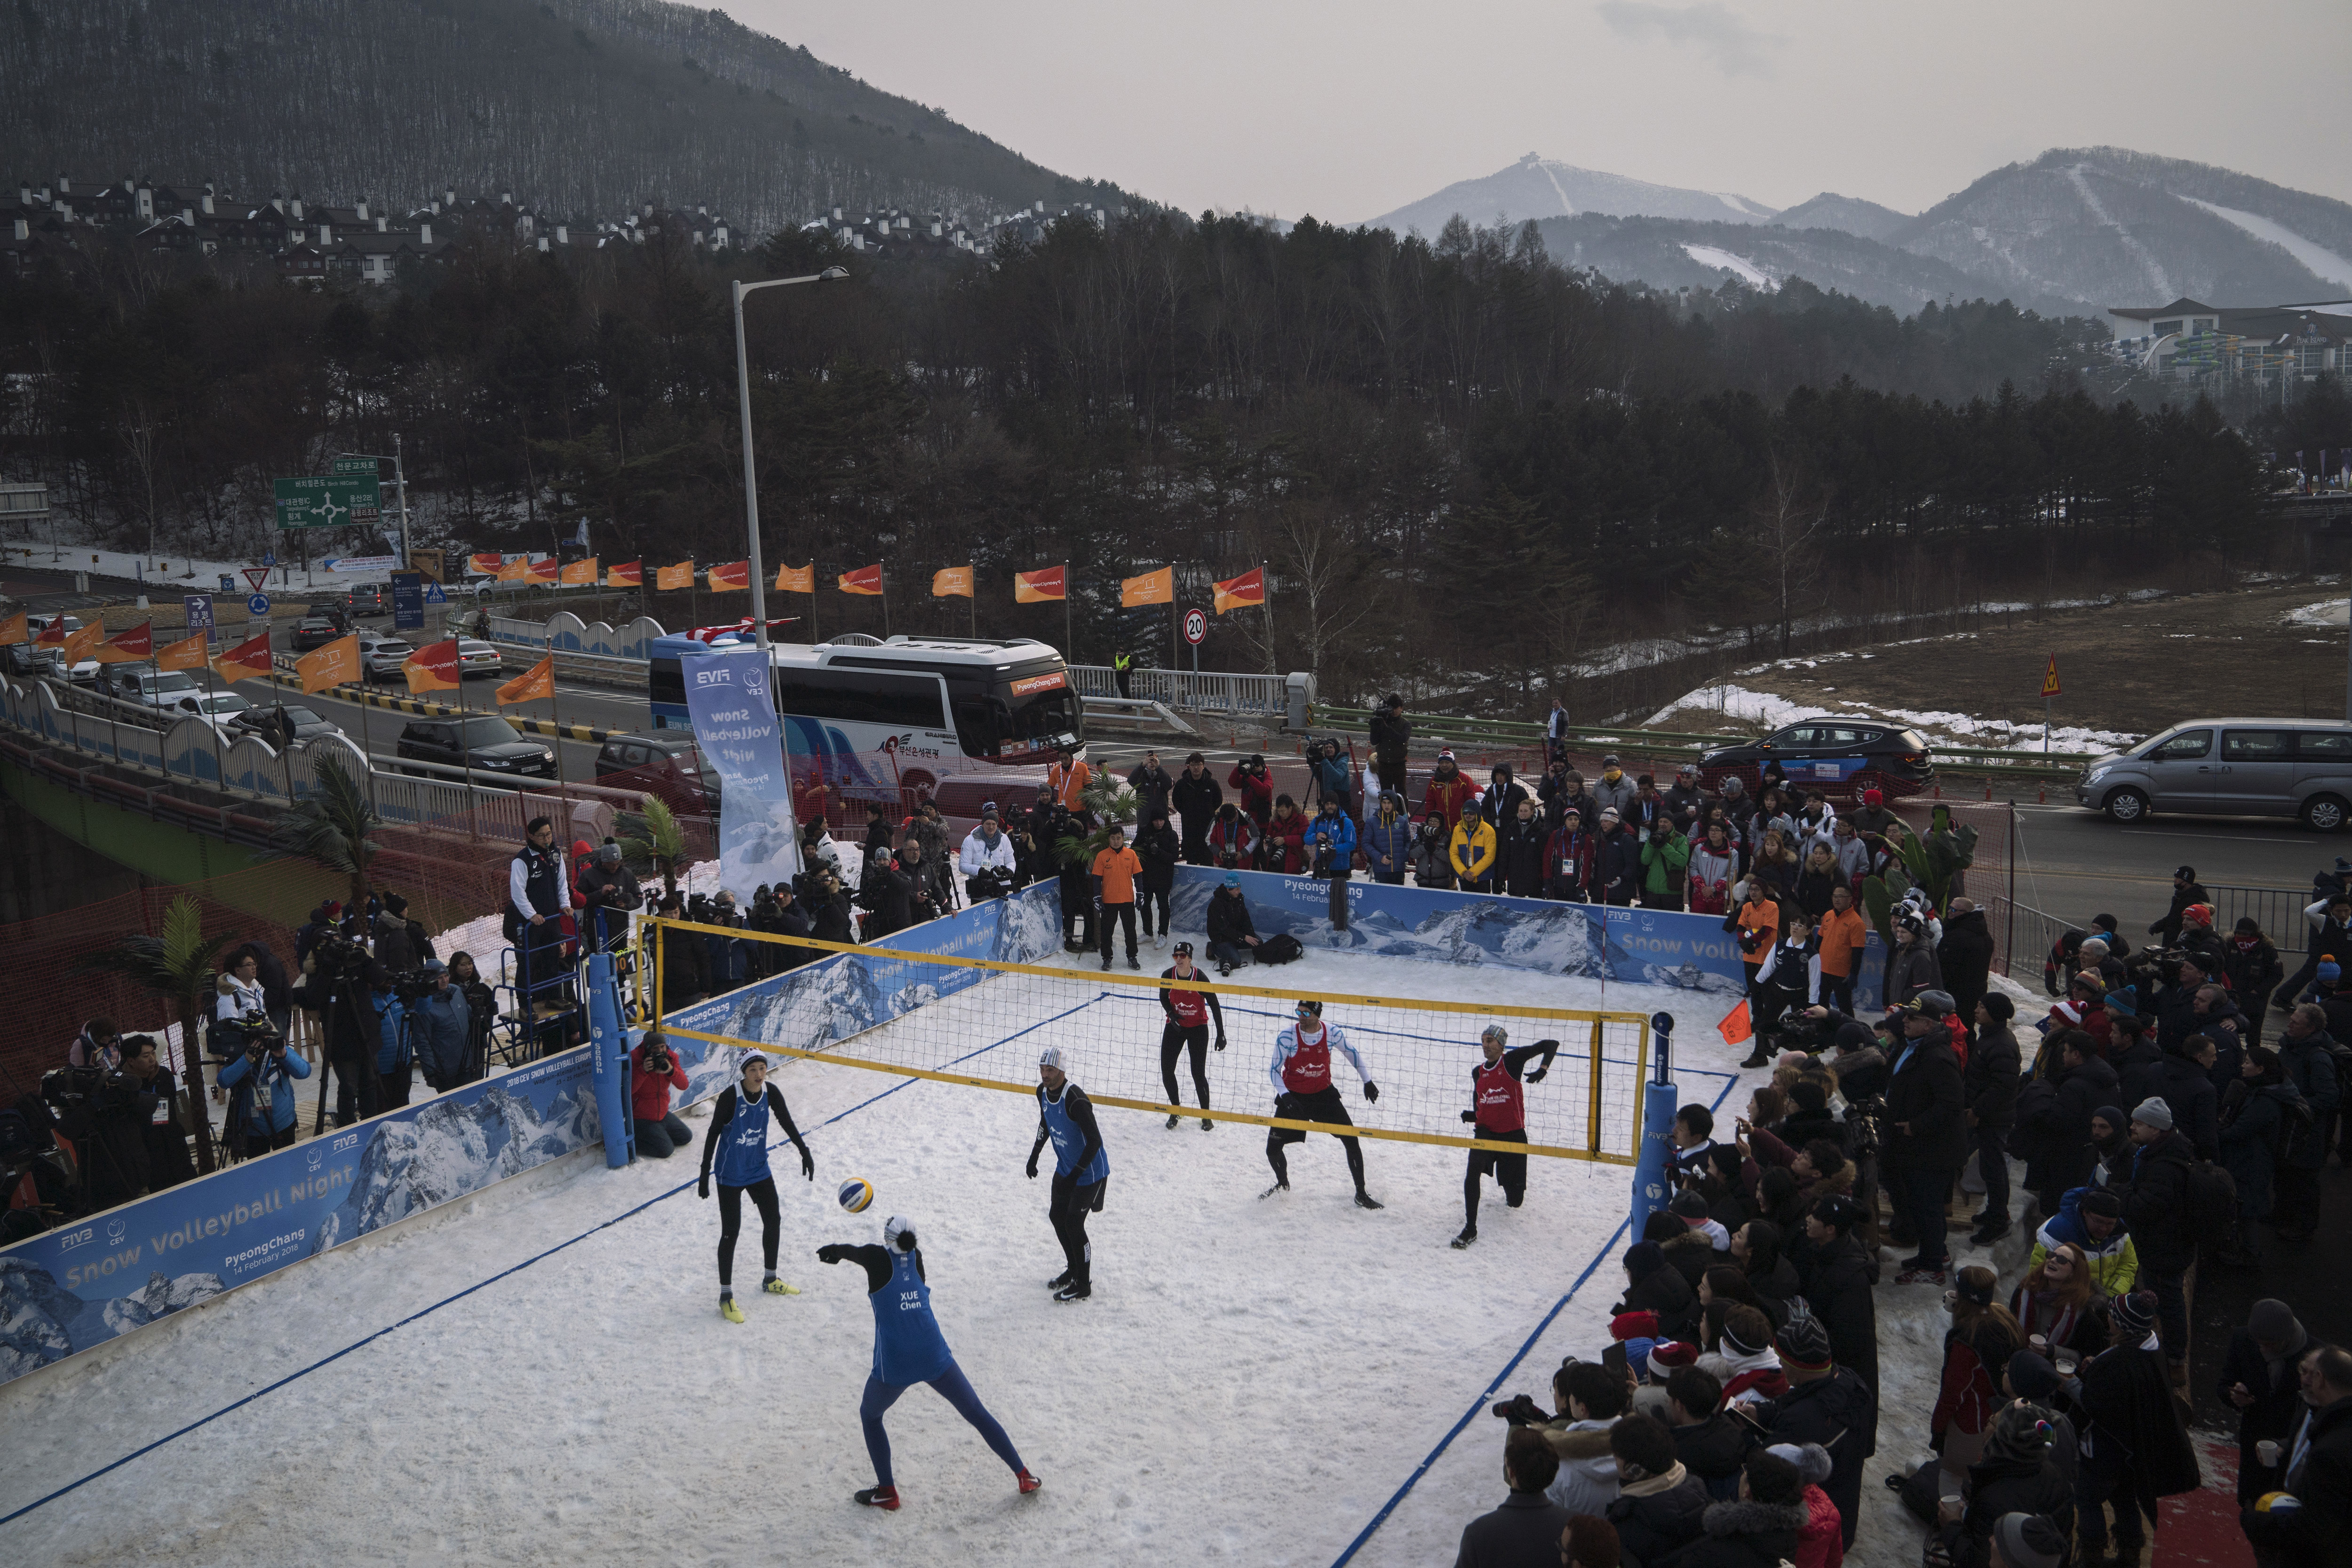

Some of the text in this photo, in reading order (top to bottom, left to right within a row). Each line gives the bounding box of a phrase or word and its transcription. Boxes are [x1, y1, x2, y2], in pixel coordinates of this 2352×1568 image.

[336, 461, 376, 470] 천문교차로
[295, 479, 326, 488] 버치힐콘도
[1189, 620, 1201, 635] 20
[668, 721, 682, 729] EUN
[925, 731, 957, 740] GRANBIRD
[899, 745, 939, 759] 부산은성관광
[984, 903, 996, 915] FIVB
[1608, 910, 1631, 921] FIVB
[966, 923, 994, 947] Night
[1622, 933, 1681, 955] Snow
[873, 959, 904, 982] Snow
[939, 967, 974, 984] PyeongChang
[680, 1002, 730, 1027] PyeongChang
[507, 1078, 519, 1088] 2018
[520, 1073, 530, 1083] CEV
[531, 1069, 545, 1079] SNOW
[546, 1059, 575, 1074] VOLLEYBALL
[333, 1133, 358, 1149] FIVB
[309, 1162, 322, 1172] CEV
[66, 1164, 353, 1288] Snow Volleyball Night
[61, 1227, 93, 1249] FIVB
[110, 1235, 125, 1246] CEV
[225, 1227, 305, 1268] PyeongChang
[234, 1243, 299, 1275] 14 February 2018
[900, 1291, 919, 1301] XUE
[900, 1301, 922, 1311] Chen
